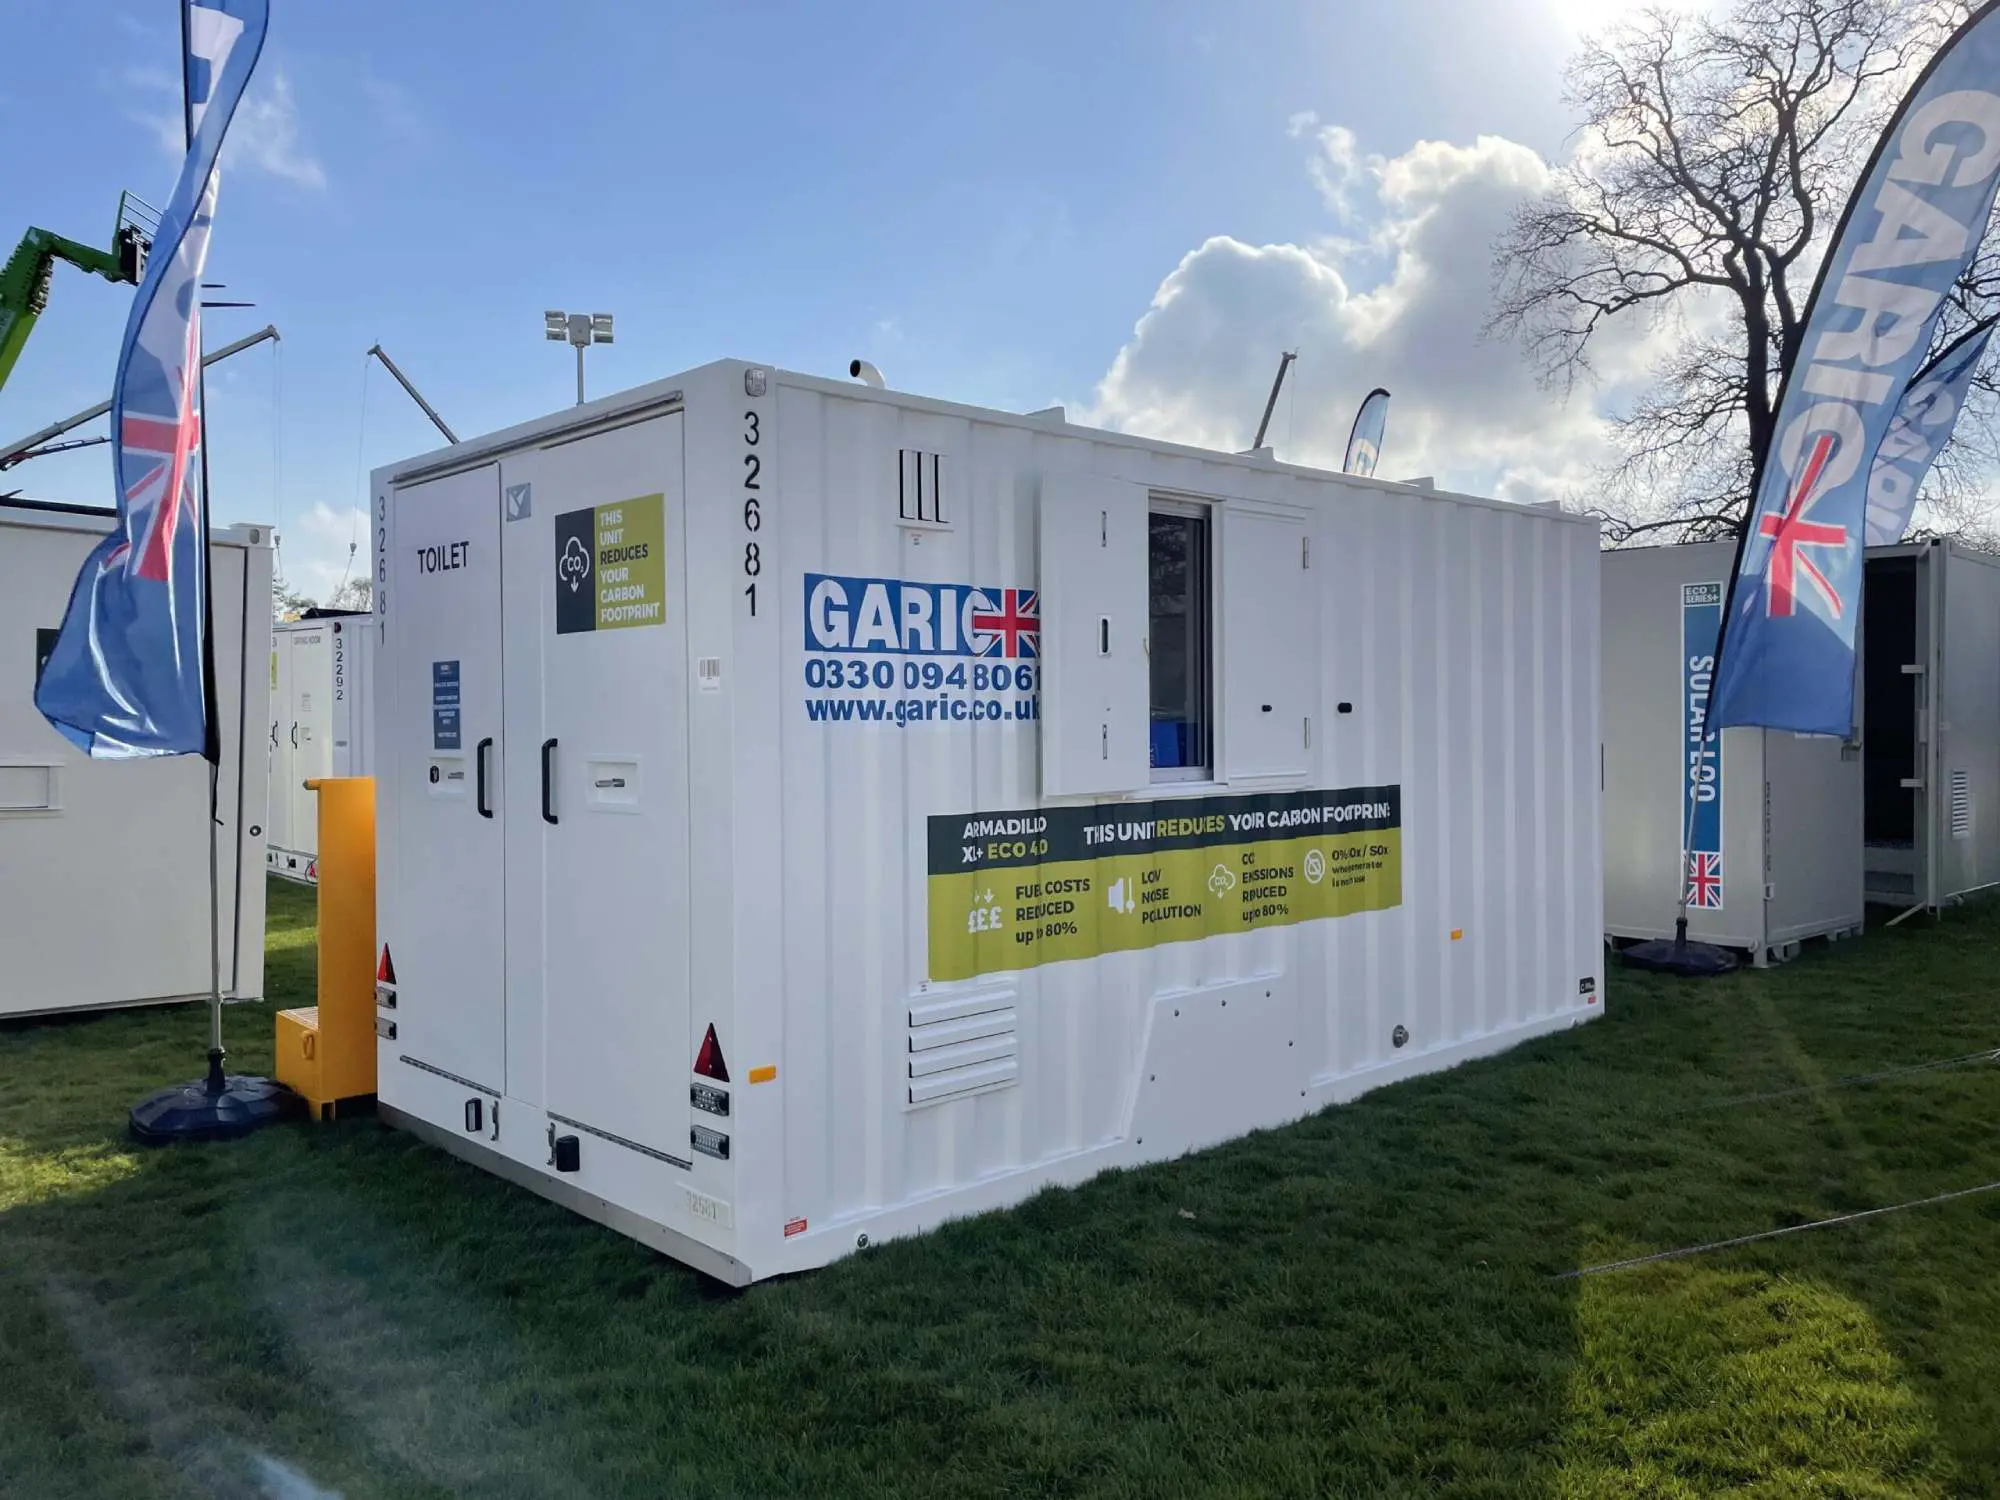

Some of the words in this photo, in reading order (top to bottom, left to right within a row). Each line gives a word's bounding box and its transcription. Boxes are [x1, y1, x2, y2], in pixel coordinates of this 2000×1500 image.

[1780, 89, 2000, 497] GARIC
[600, 509, 623, 527] THIS
[744, 411, 761, 617] 32681
[600, 529, 625, 546] UNIT
[417, 541, 470, 574] TOILET
[600, 543, 648, 565] REDUCES
[378, 496, 386, 646] 32681
[600, 567, 629, 584] YOUR
[601, 583, 644, 603] CARBON
[1686, 586, 1708, 595] ECO
[601, 602, 660, 623] FOOTPRINT
[809, 578, 996, 657] GARIC
[335, 638, 344, 700] 32292
[805, 658, 895, 690] 0330
[903, 660, 967, 690] 094
[963, 816, 1047, 839] ARMADILLO
[1083, 823, 1115, 845] THIS
[1157, 814, 1225, 838] REDUES
[987, 841, 1026, 860] ECO
[1030, 838, 1049, 856] 40
[1045, 878, 1090, 895] COSTS
[1262, 903, 1289, 917] 80%
[1016, 930, 1034, 946] up
[1045, 921, 1078, 938] 80%
